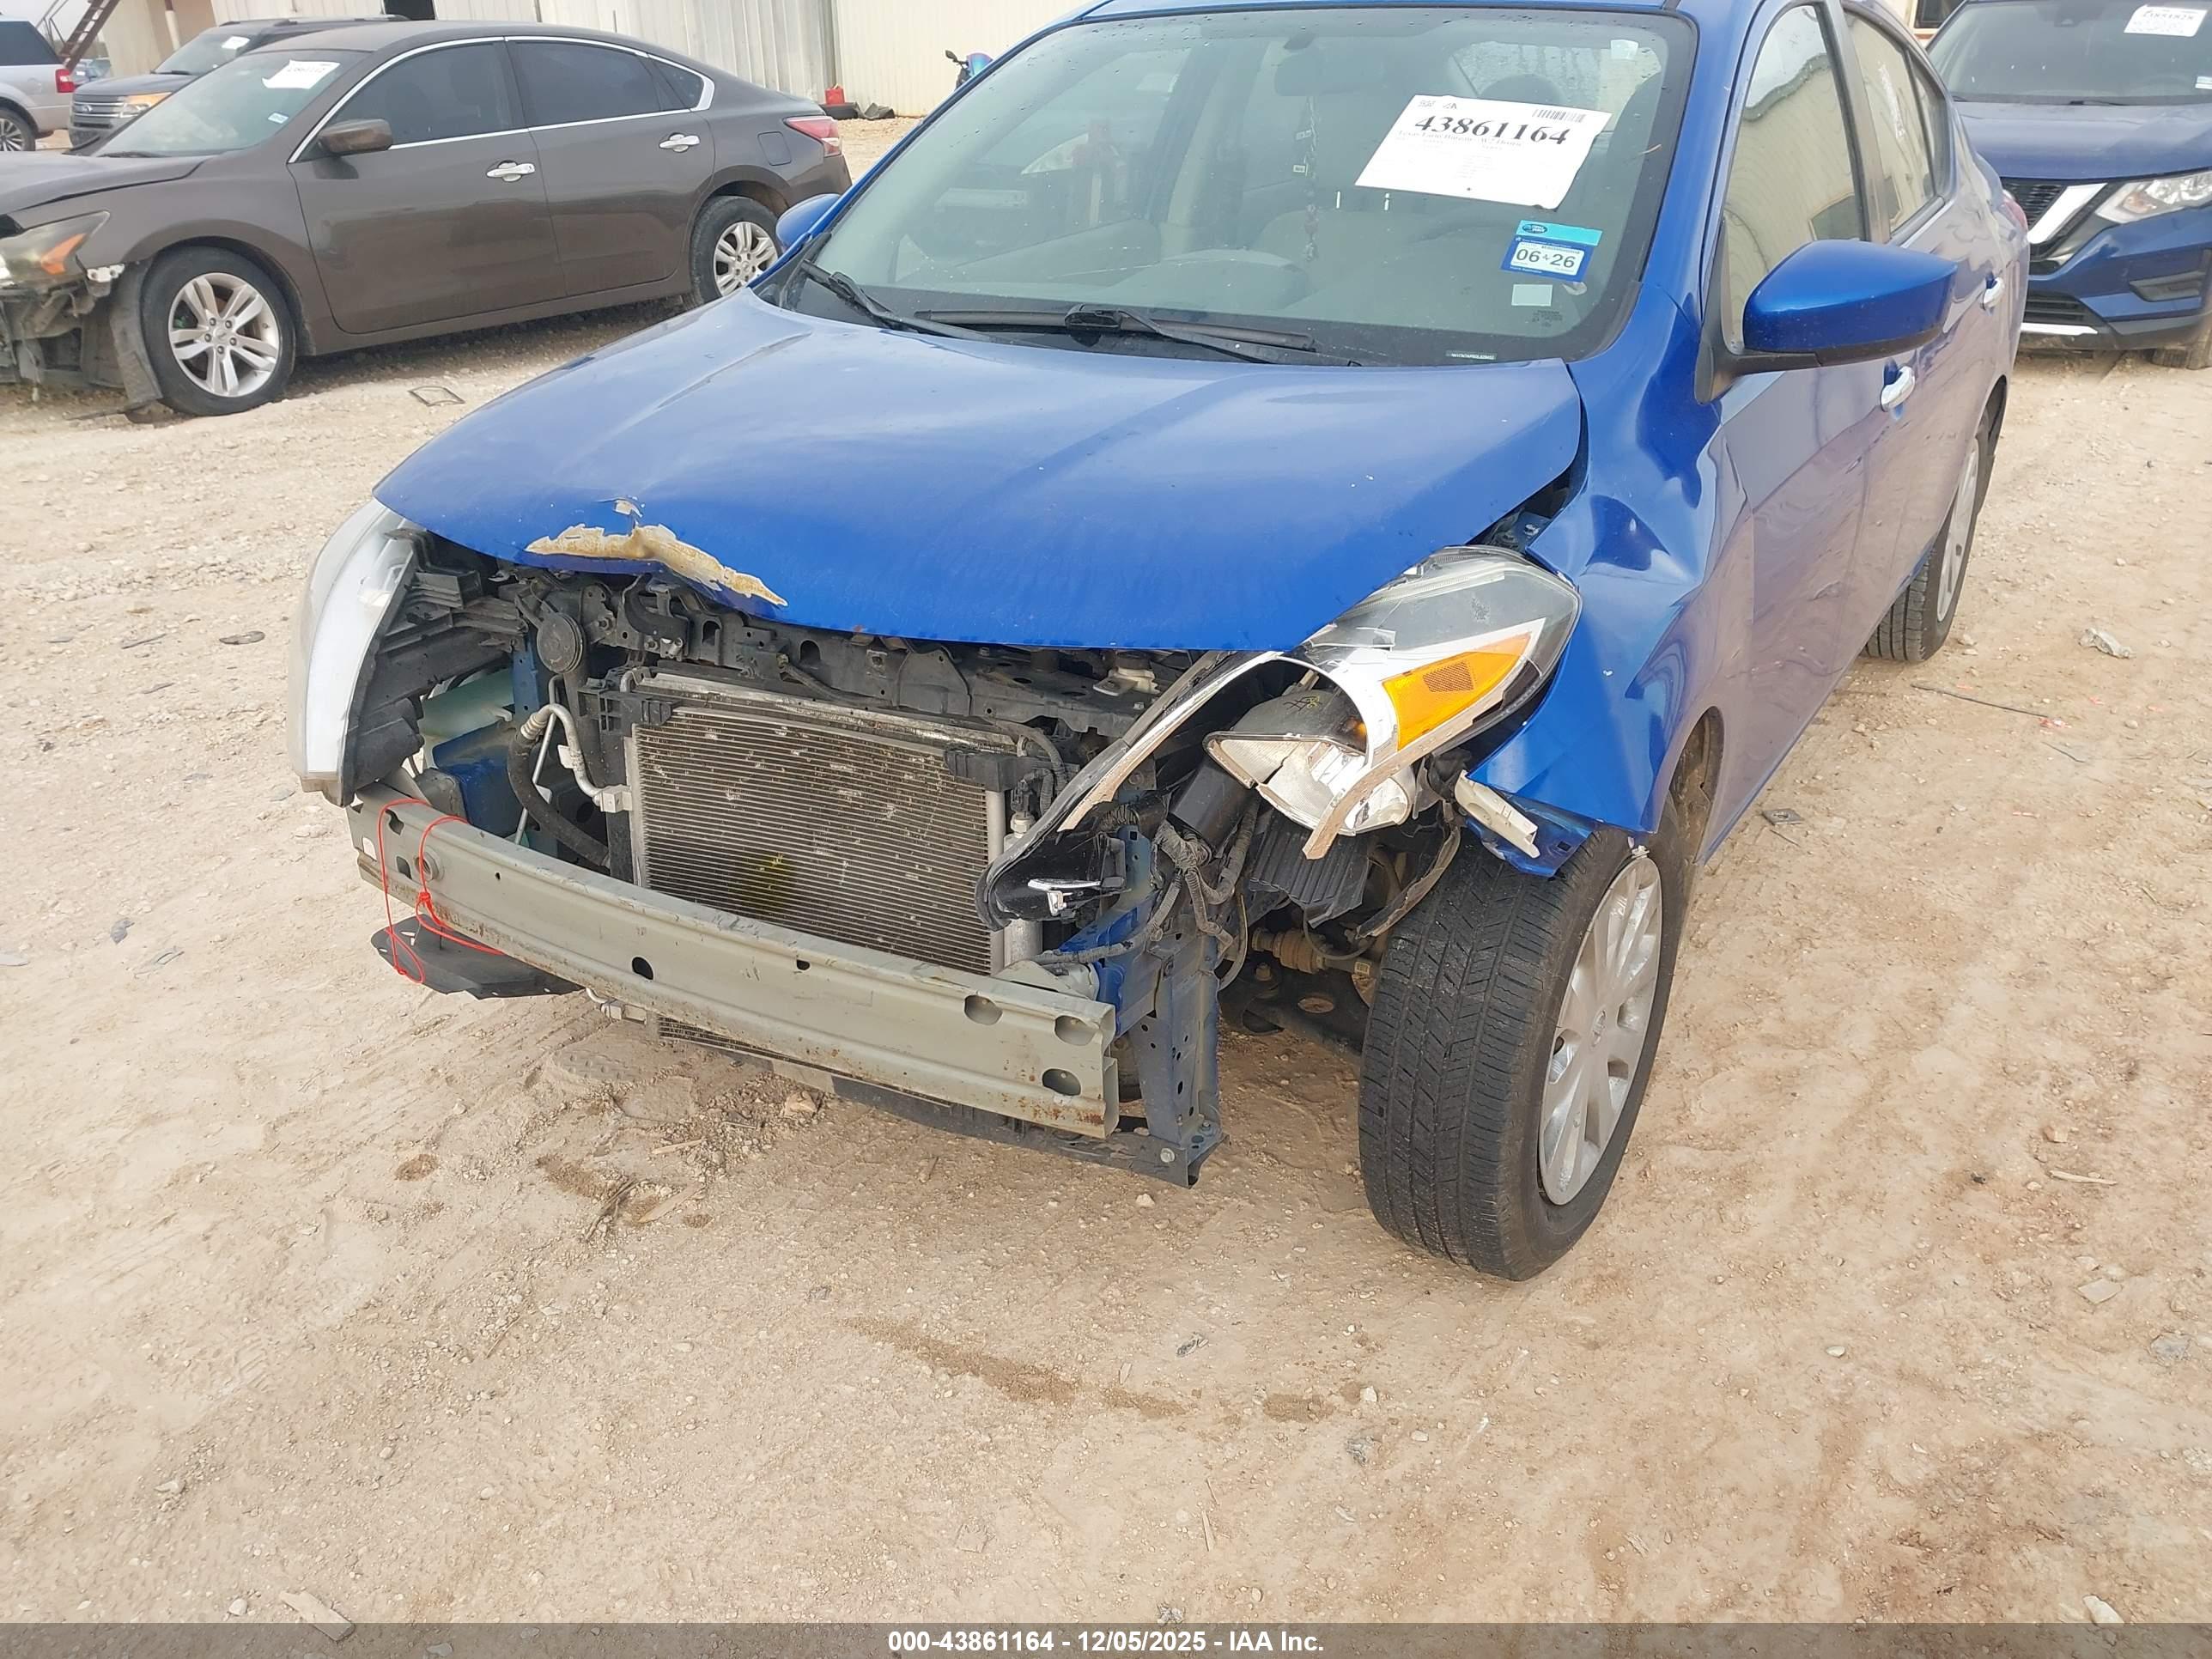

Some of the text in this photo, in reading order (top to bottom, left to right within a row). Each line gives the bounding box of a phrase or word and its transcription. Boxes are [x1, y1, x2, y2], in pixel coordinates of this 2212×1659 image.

[1414, 114, 1572, 145] 43861164
[1516, 248, 1542, 263] 06
[1549, 253, 1577, 269] 26
